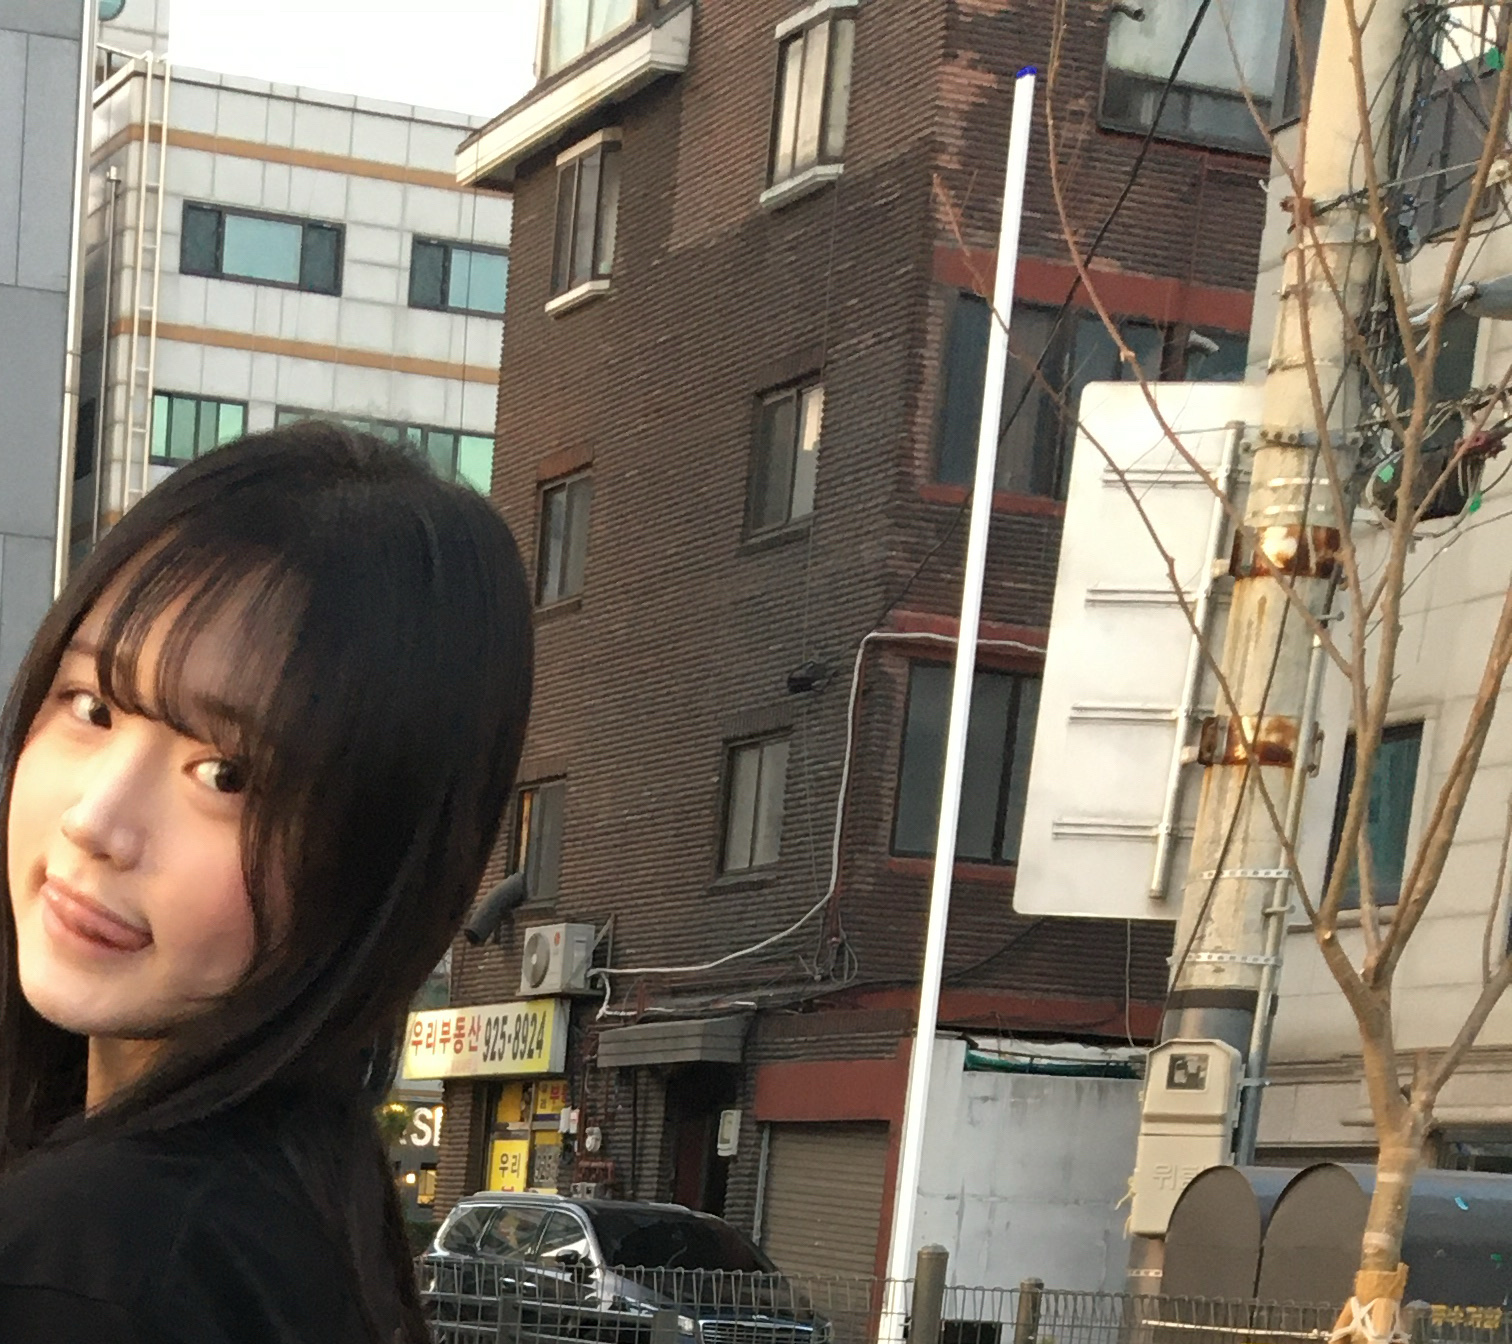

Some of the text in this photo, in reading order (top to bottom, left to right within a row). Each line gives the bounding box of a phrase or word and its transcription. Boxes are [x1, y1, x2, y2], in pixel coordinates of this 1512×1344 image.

[411, 1010, 548, 1063] 우리부동산 925-8924
[498, 1152, 521, 1179] 우리
